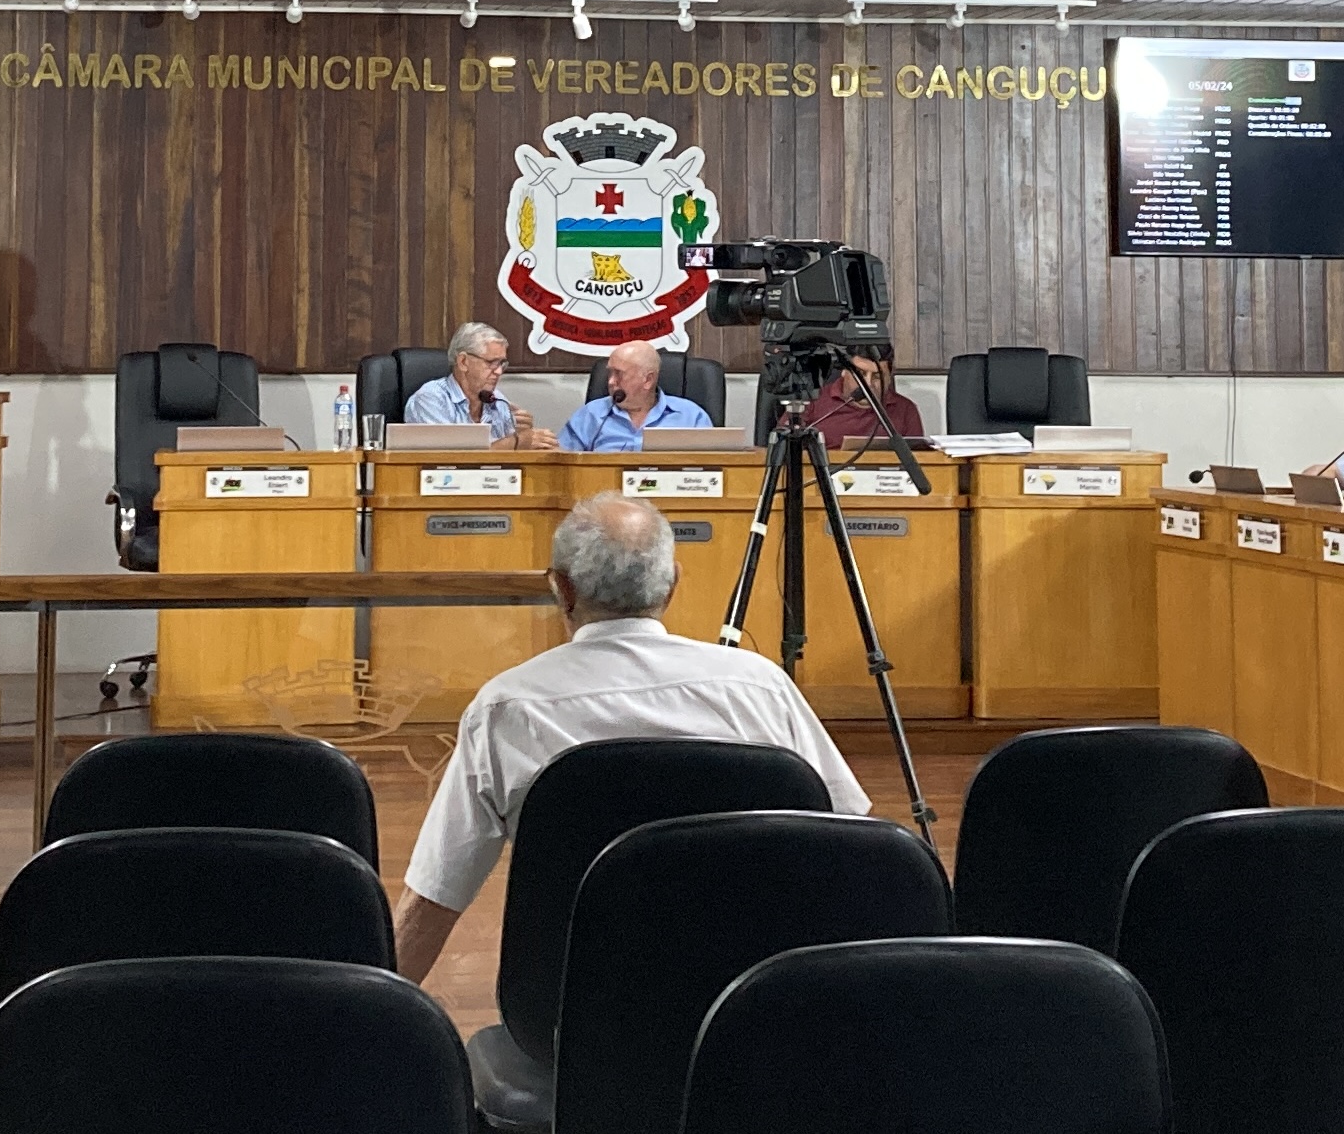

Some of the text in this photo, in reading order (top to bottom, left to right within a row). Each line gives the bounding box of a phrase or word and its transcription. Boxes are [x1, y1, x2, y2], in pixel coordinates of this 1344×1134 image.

[0, 43, 1108, 109] CÂMARA MUNICIPAL DE VEREADORES DE CANGUÇU
[1188, 81, 1233, 91] 05/02/24
[576, 280, 644, 299] CANGUÇU
[442, 521, 506, 529] VICE-PRESIDENTE
